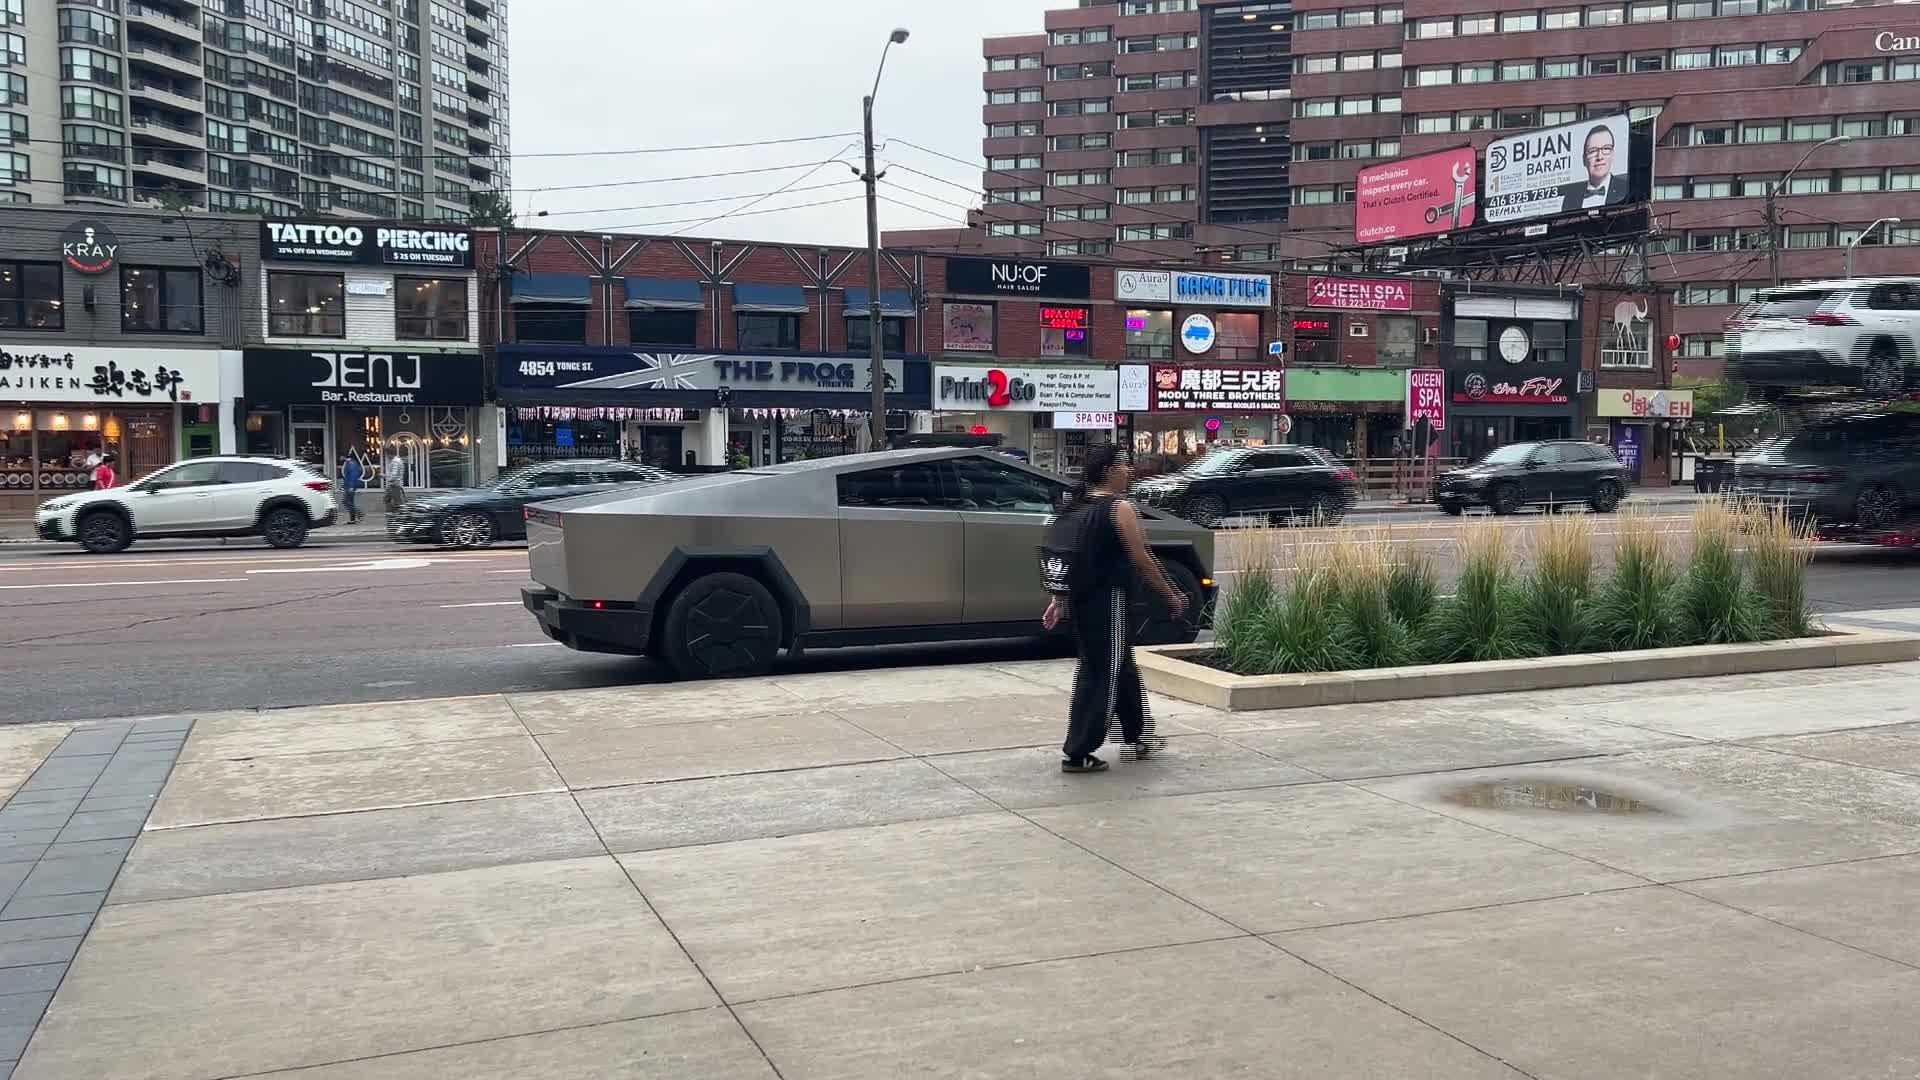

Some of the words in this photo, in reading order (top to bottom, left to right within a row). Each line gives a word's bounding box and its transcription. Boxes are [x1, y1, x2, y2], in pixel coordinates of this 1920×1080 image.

[1512, 132, 1571, 162] BIJAN
[1526, 156, 1571, 176] BARATI
[1362, 176, 1368, 184] 8
[1369, 168, 1409, 183] mechanics
[1362, 183, 1390, 196] inspect
[1391, 181, 1412, 191] every
[1413, 178, 1429, 186] car.
[1363, 200, 1381, 209] That's
[1383, 195, 1405, 206] Clutch
[1406, 189, 1440, 201] Certified.
[1489, 196, 1506, 207] 416
[1509, 191, 1529, 204] 825
[1532, 186, 1559, 201] 7373
[1489, 205, 1522, 218] RE/MAX
[267, 223, 364, 246] TATTOO
[376, 228, 469, 251] PIERCING
[63, 243, 118, 257] KRAY
[422, 254, 454, 262] TUESDAY
[992, 264, 1048, 283] NU:OF
[1139, 272, 1168, 284] Aura9
[1314, 282, 1370, 299] QUEEN
[1374, 285, 1406, 300] SPA
[1349, 300, 1386, 308] 223-1772
[1044, 309, 1064, 319] SPA
[519, 361, 555, 376] 4854
[556, 362, 581, 371] YONGE
[581, 362, 594, 371] ST.
[715, 360, 773, 381] THE
[781, 362, 855, 382] FROG
[941, 370, 1036, 407] Print2Go
[1180, 369, 1281, 391] 魔都三兄弟
[1411, 373, 1441, 388] QUEEN
[1158, 391, 1189, 400] MODU
[1193, 391, 1225, 400] THREE
[1228, 392, 1281, 401] BROTHERS
[1419, 388, 1441, 407] SPA
[1075, 413, 1092, 423] SPA
[1095, 414, 1113, 423] ONE
[1433, 410, 1439, 418] A
